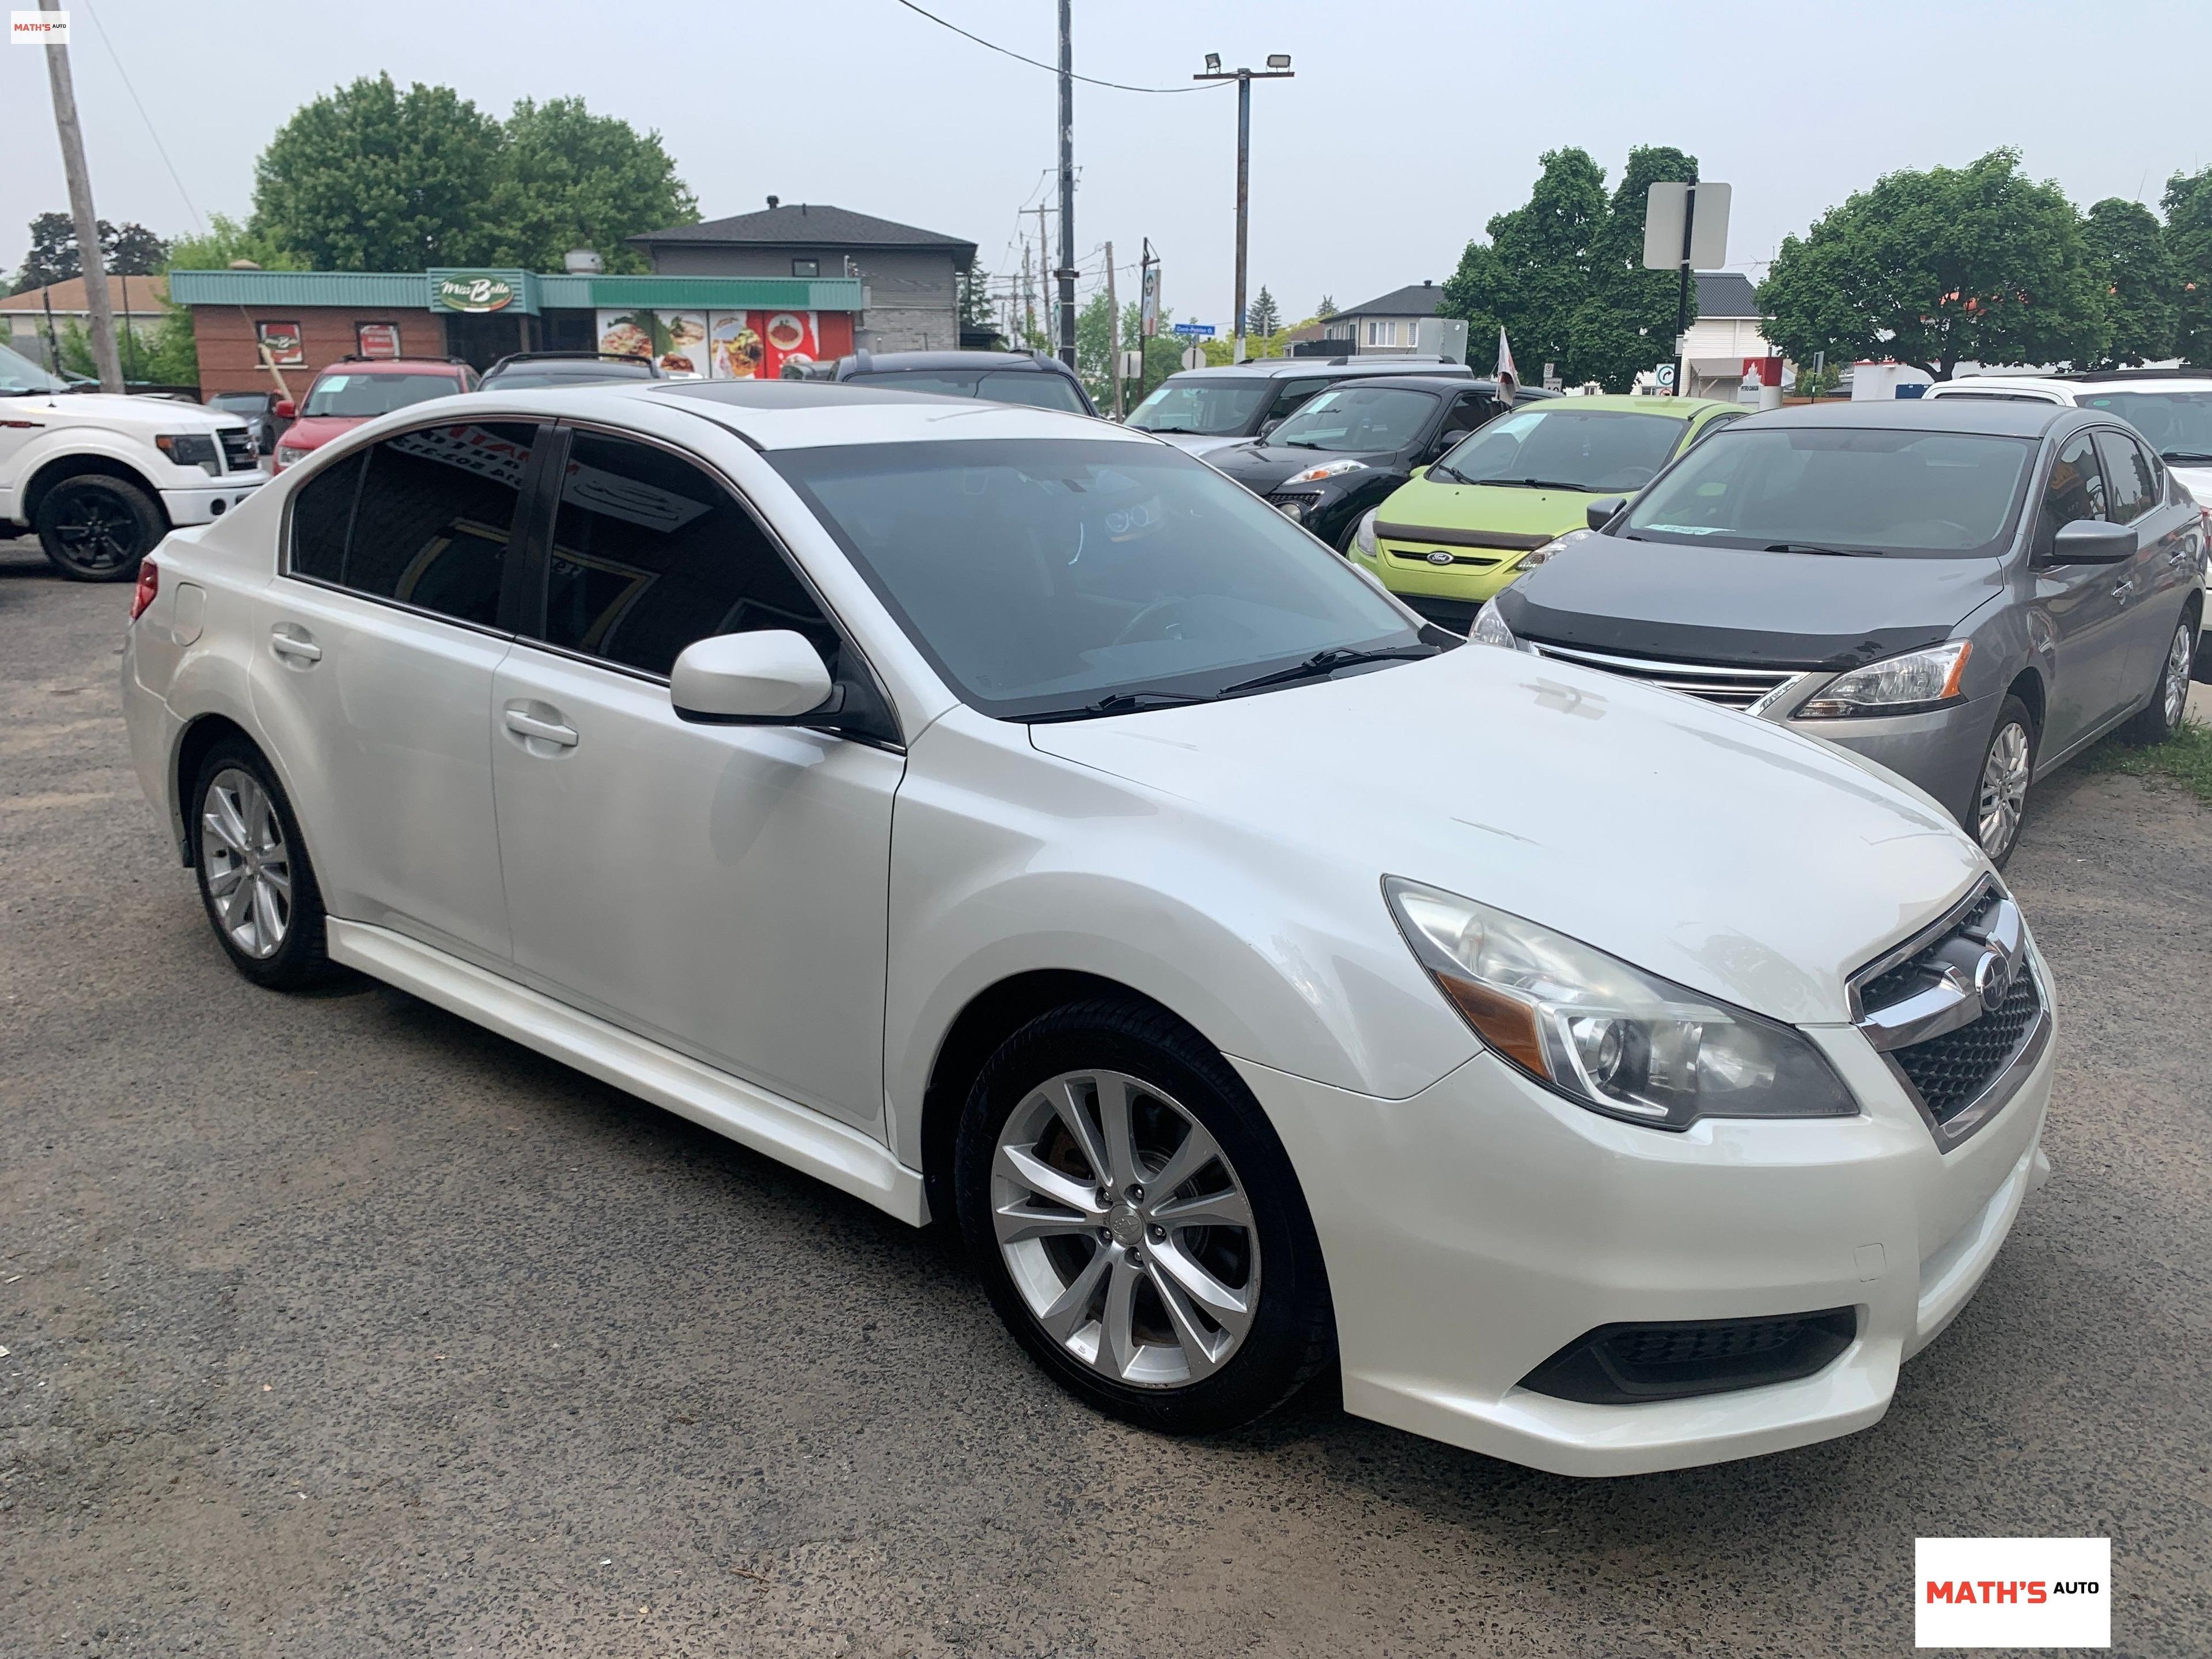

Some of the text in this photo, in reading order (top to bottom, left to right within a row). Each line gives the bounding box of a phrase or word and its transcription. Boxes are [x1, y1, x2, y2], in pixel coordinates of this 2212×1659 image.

[441, 281, 471, 295] Miss
[469, 278, 510, 303] Bella
[1431, 553, 1447, 562] Ford
